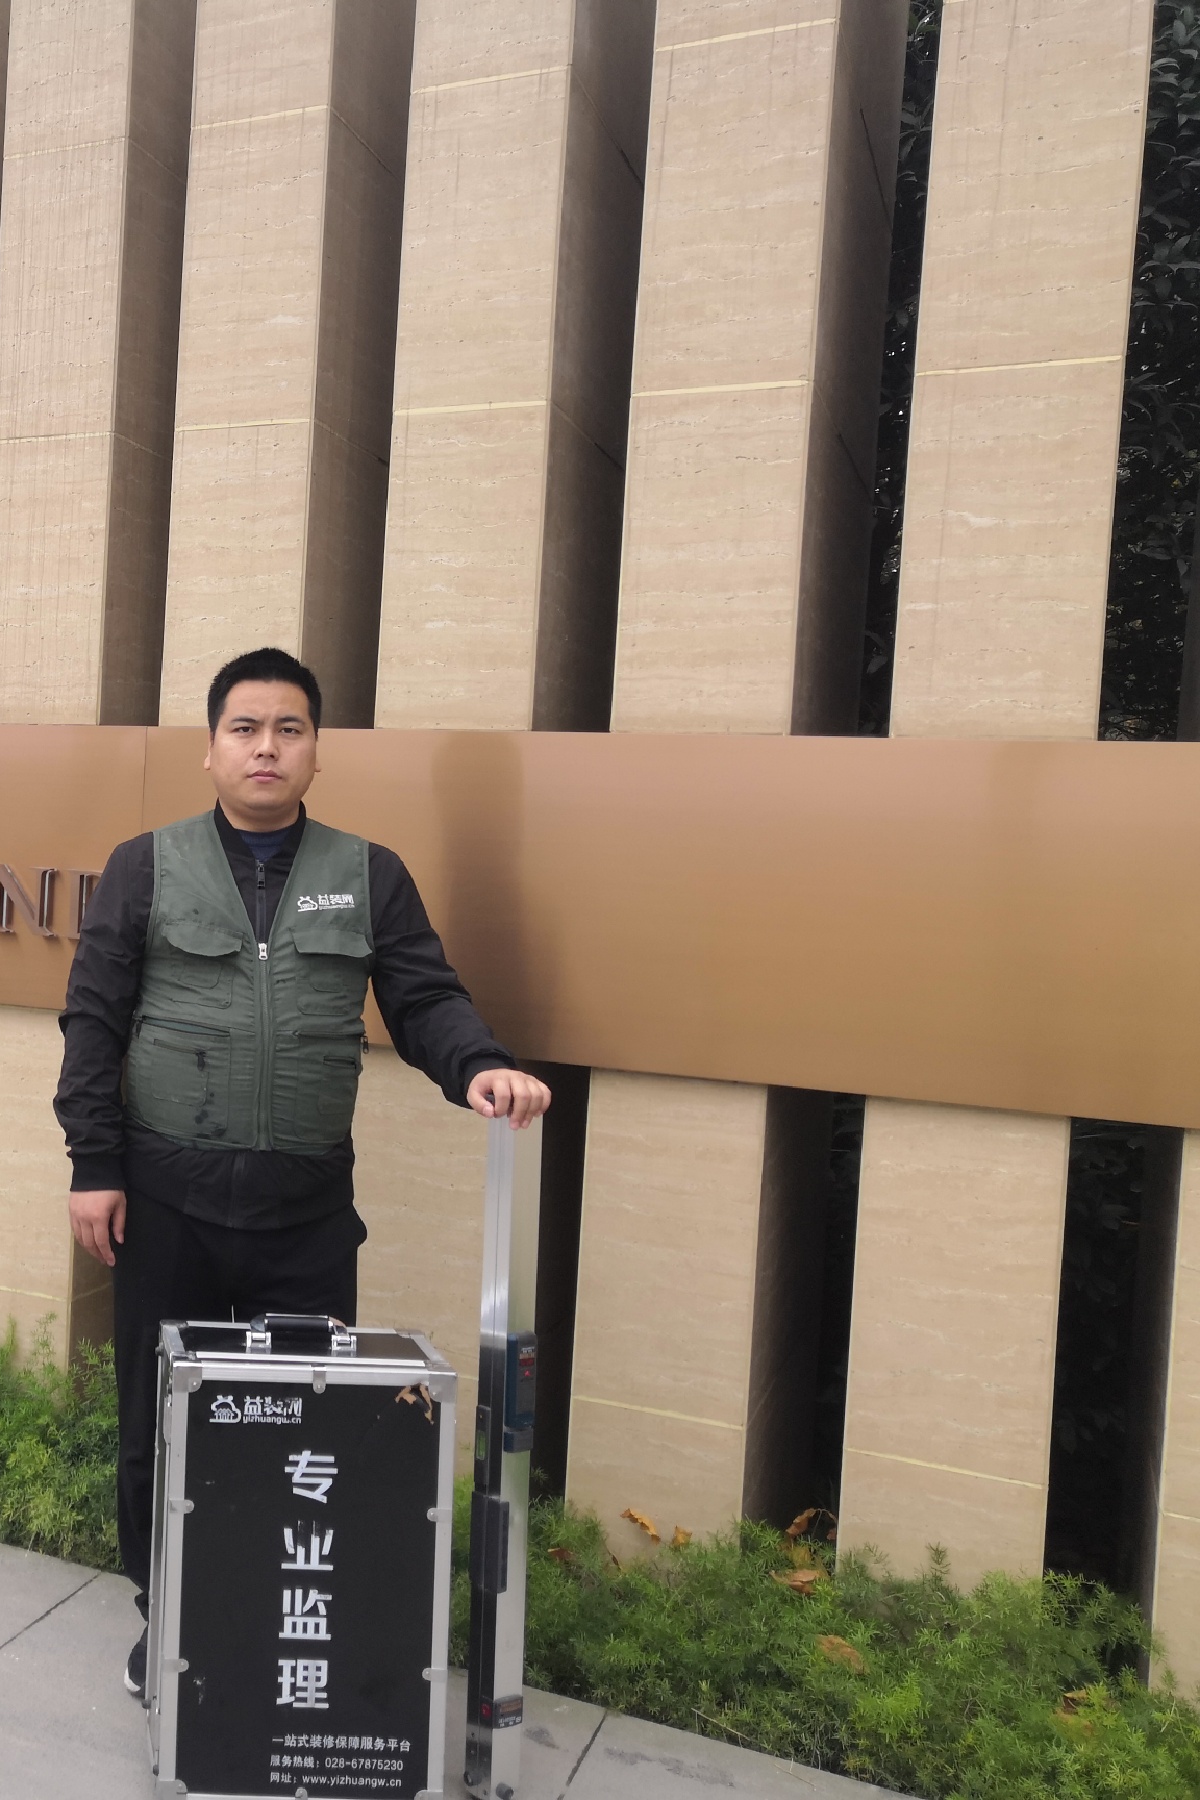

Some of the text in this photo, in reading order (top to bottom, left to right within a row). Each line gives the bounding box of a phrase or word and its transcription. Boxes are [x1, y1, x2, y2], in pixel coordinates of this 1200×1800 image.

[275, 1450, 339, 1710] 专业监理
[272, 1733, 411, 1752] 一站式装修保障服务平台
